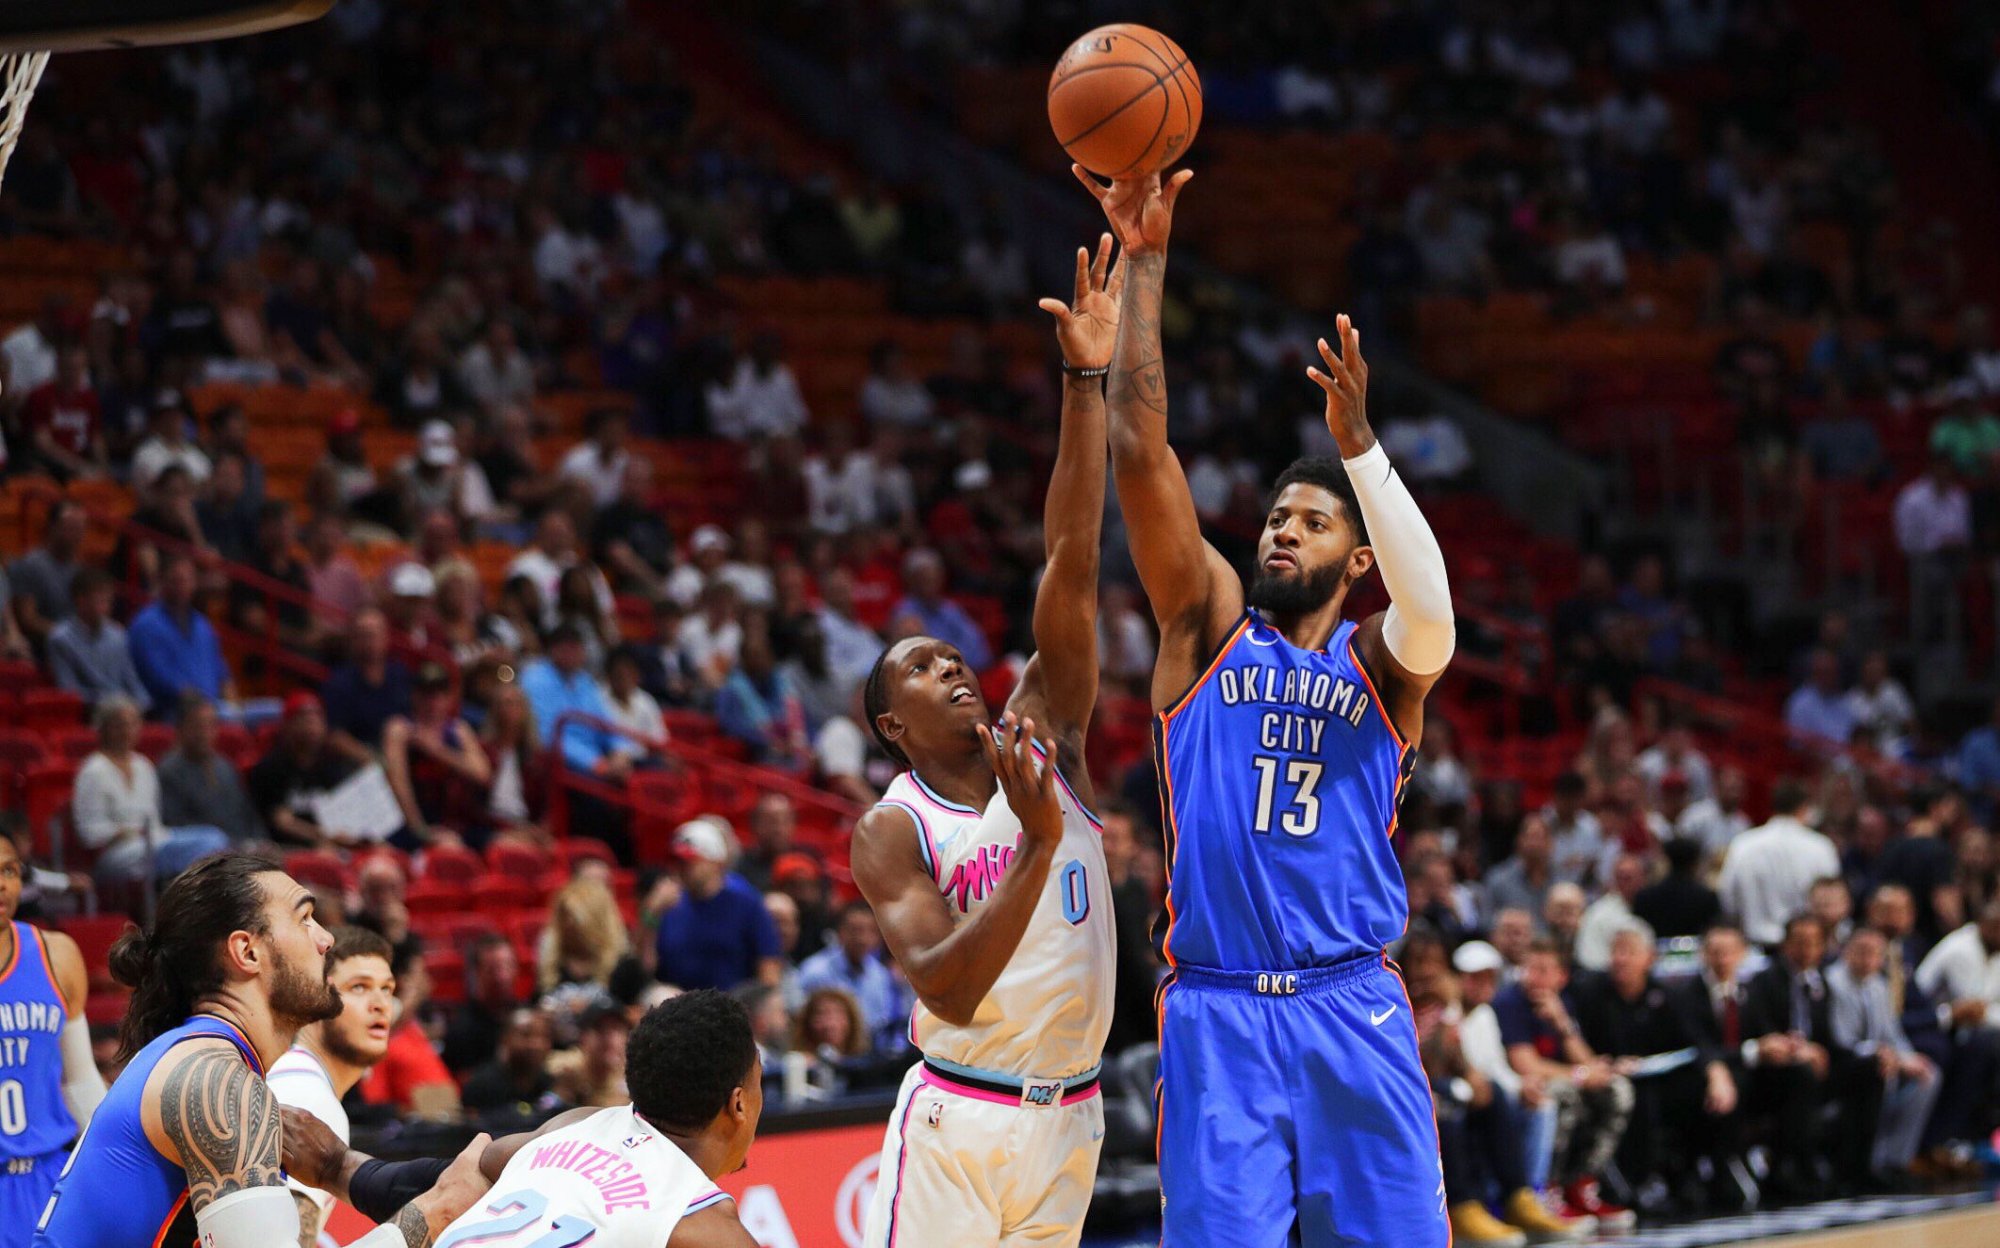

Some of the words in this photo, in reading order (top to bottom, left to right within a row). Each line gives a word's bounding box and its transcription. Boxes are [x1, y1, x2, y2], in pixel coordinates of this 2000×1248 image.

[1219, 665, 1369, 729] OKLAHOMA
[1261, 712, 1325, 754] CITY
[1252, 755, 1326, 839] 13
[1060, 859, 1091, 927] 0
[1256, 973, 1297, 995] OKC
[0, 1078, 28, 1136] 0
[529, 1139, 650, 1216] WHITESIDE
